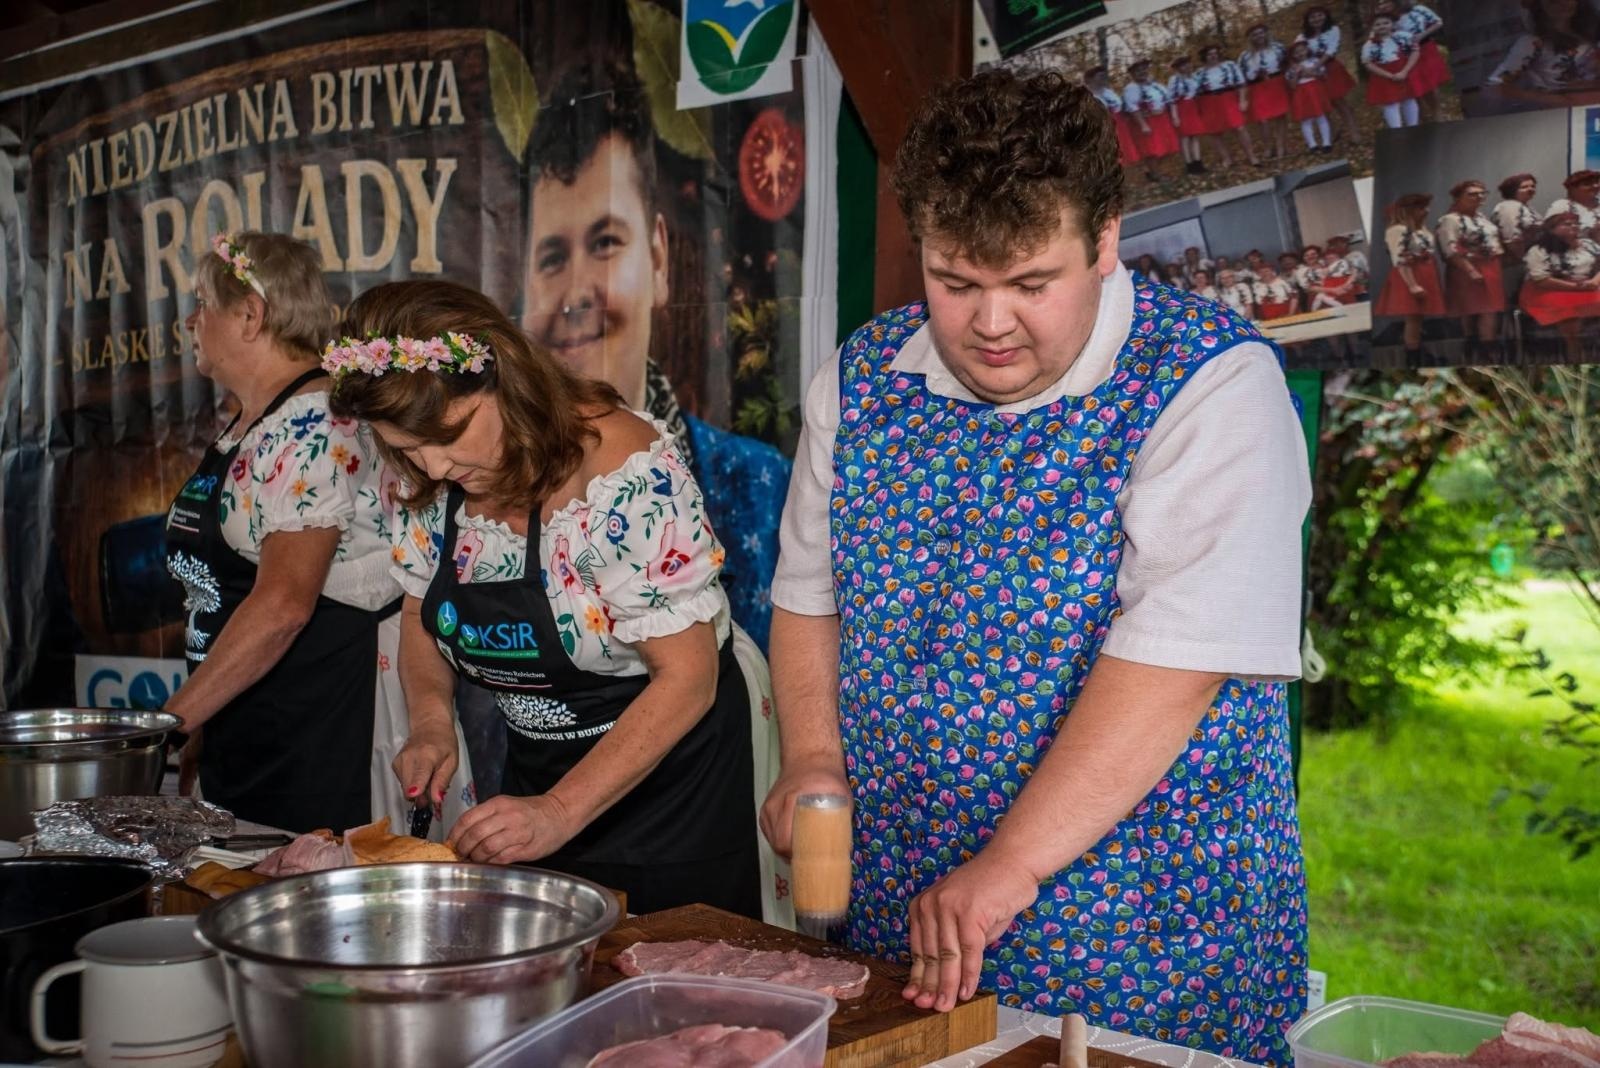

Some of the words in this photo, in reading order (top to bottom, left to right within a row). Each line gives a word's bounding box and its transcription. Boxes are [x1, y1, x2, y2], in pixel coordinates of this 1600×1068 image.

[66, 79, 298, 206] NIEDZIELNA
[311, 59, 465, 136] BITWA
[63, 237, 131, 308] NA
[565, 731, 576, 740] W
